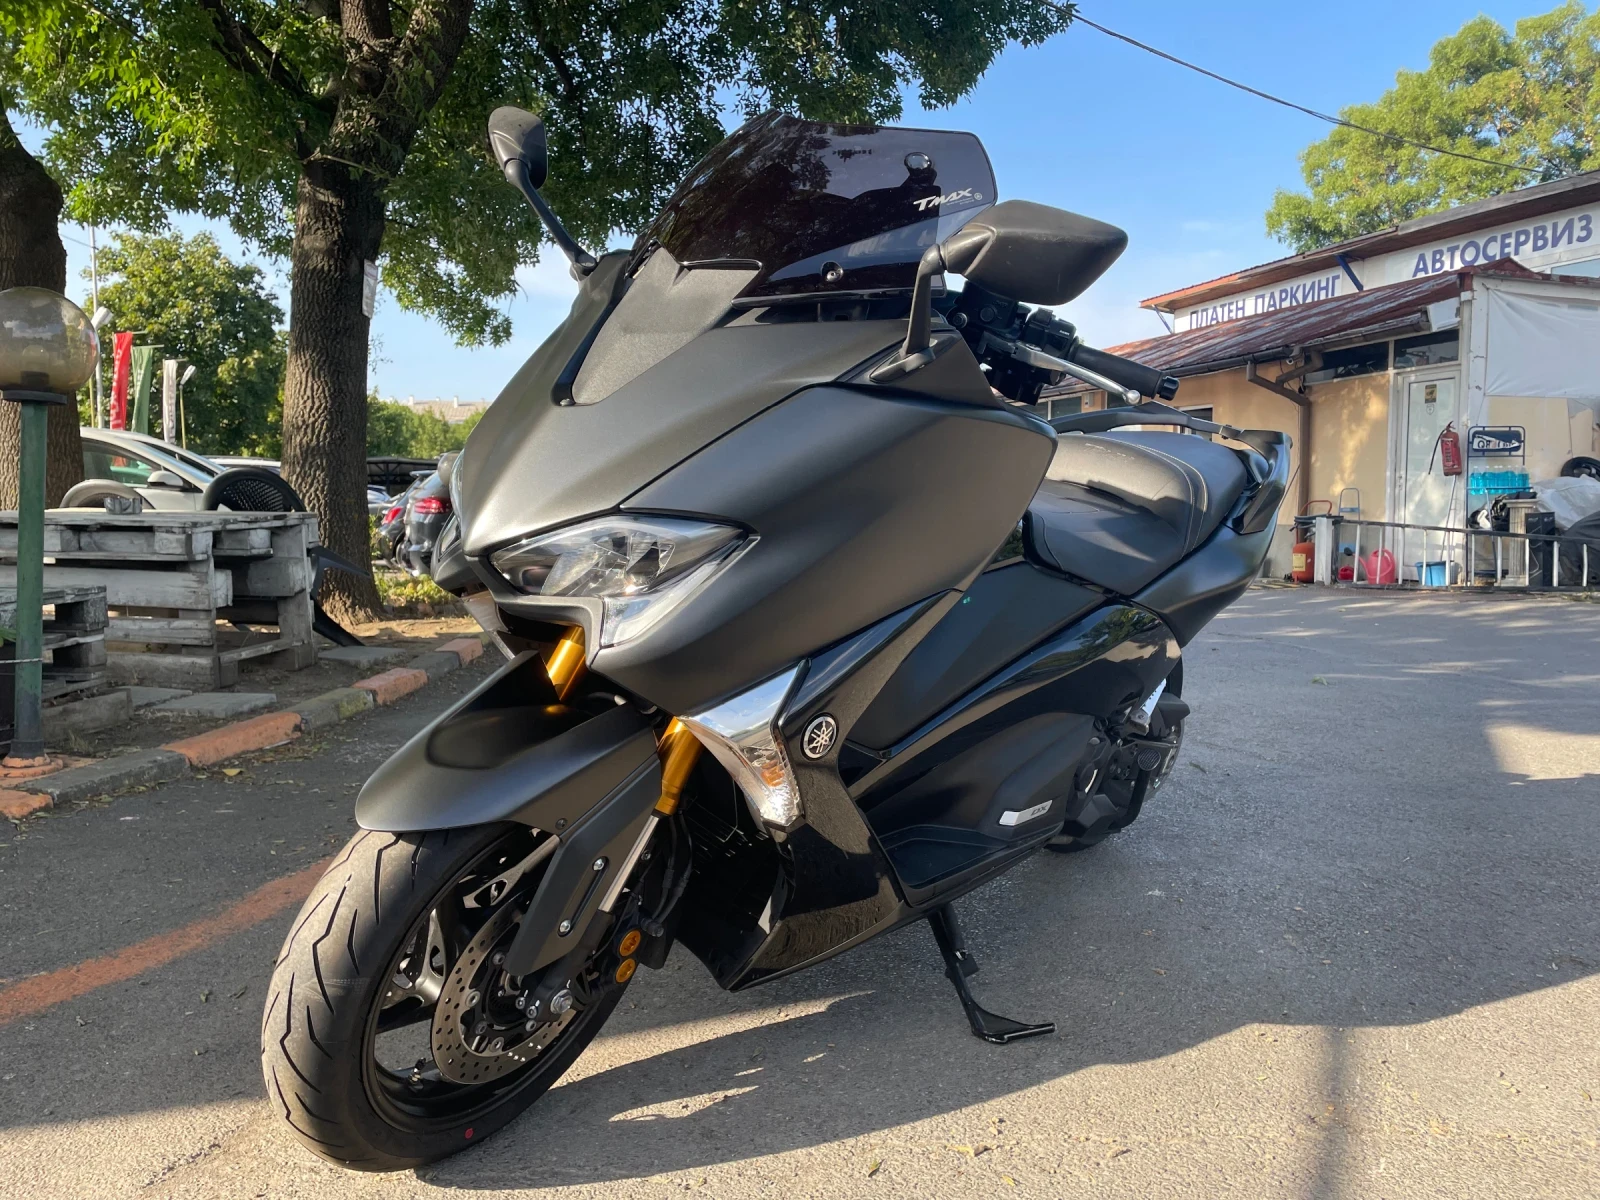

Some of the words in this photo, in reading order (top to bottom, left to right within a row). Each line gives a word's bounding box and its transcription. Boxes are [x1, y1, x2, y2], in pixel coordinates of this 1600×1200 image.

[913, 188, 972, 211] TMAX
[1412, 213, 1593, 278] АВТОСЕРВИЗ
[1189, 298, 1246, 330] ПЛАТЕН
[1254, 274, 1341, 315] ПАРКИНГ
